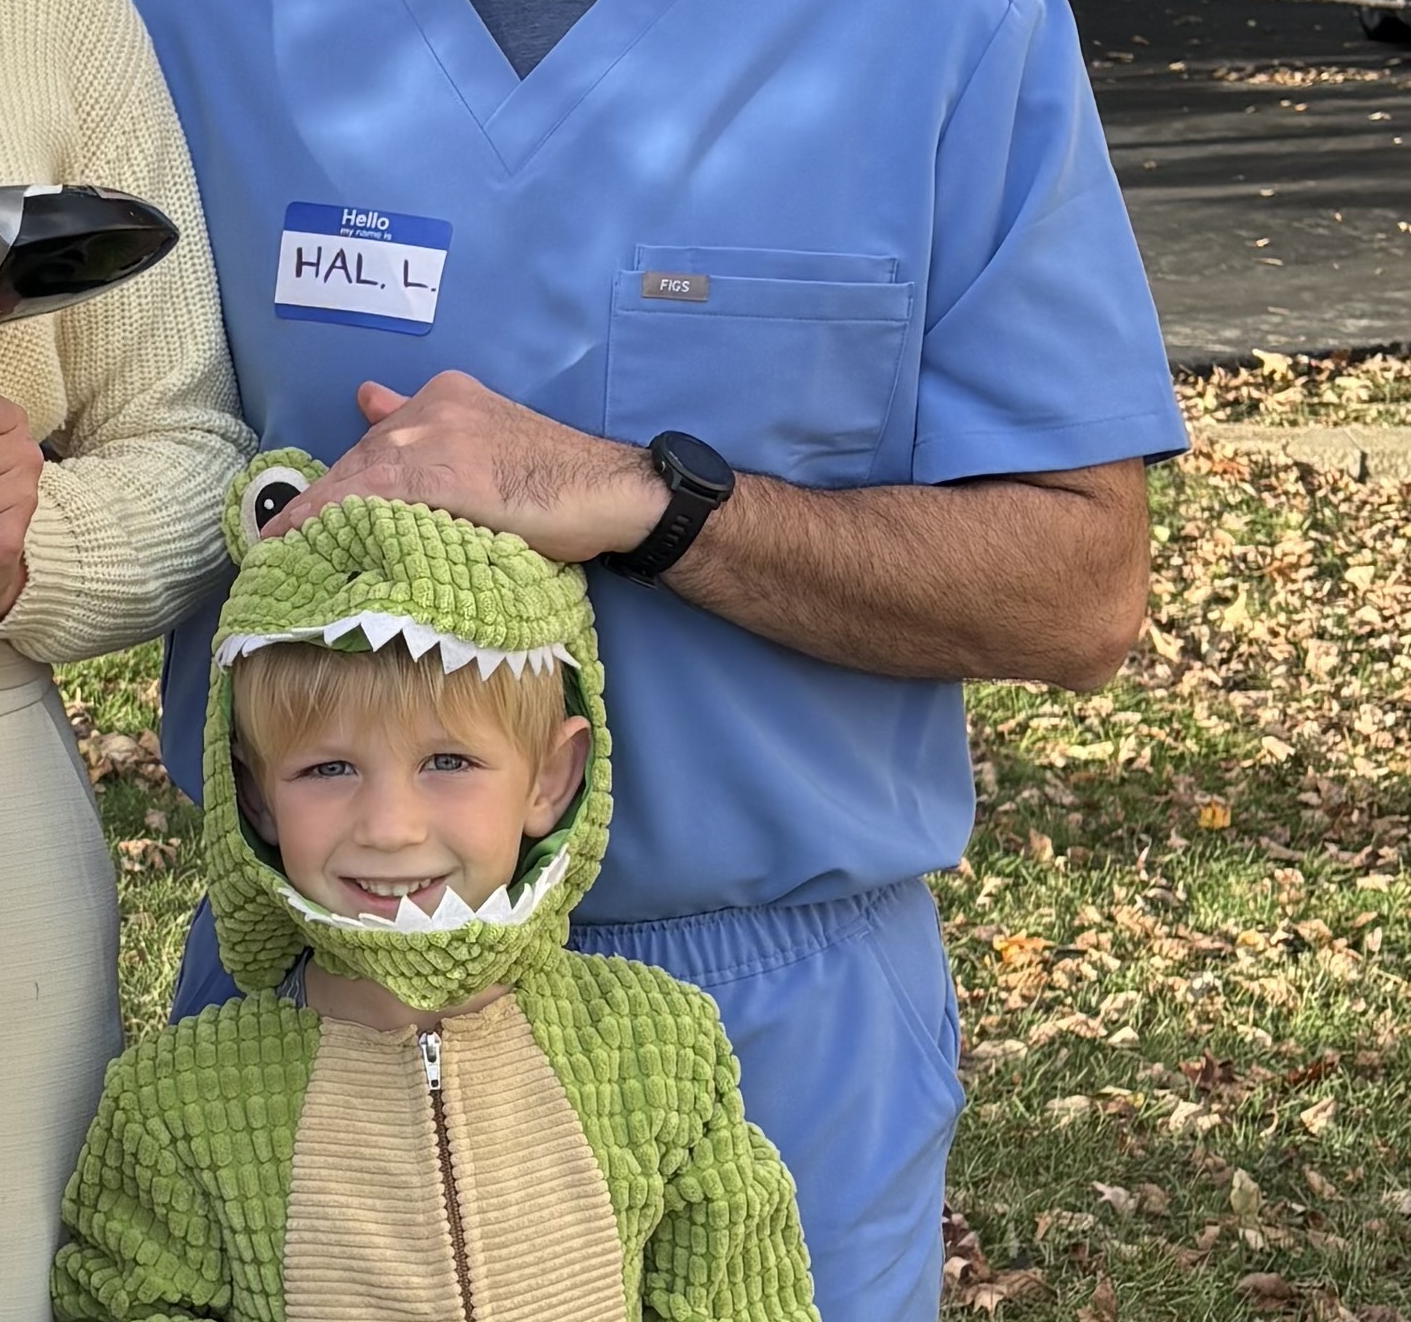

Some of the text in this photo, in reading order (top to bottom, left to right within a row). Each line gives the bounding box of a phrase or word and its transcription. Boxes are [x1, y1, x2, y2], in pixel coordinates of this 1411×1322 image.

[341, 208, 390, 230] Hello
[295, 246, 437, 292] HAL. L.
[659, 278, 690, 293] FIGS
